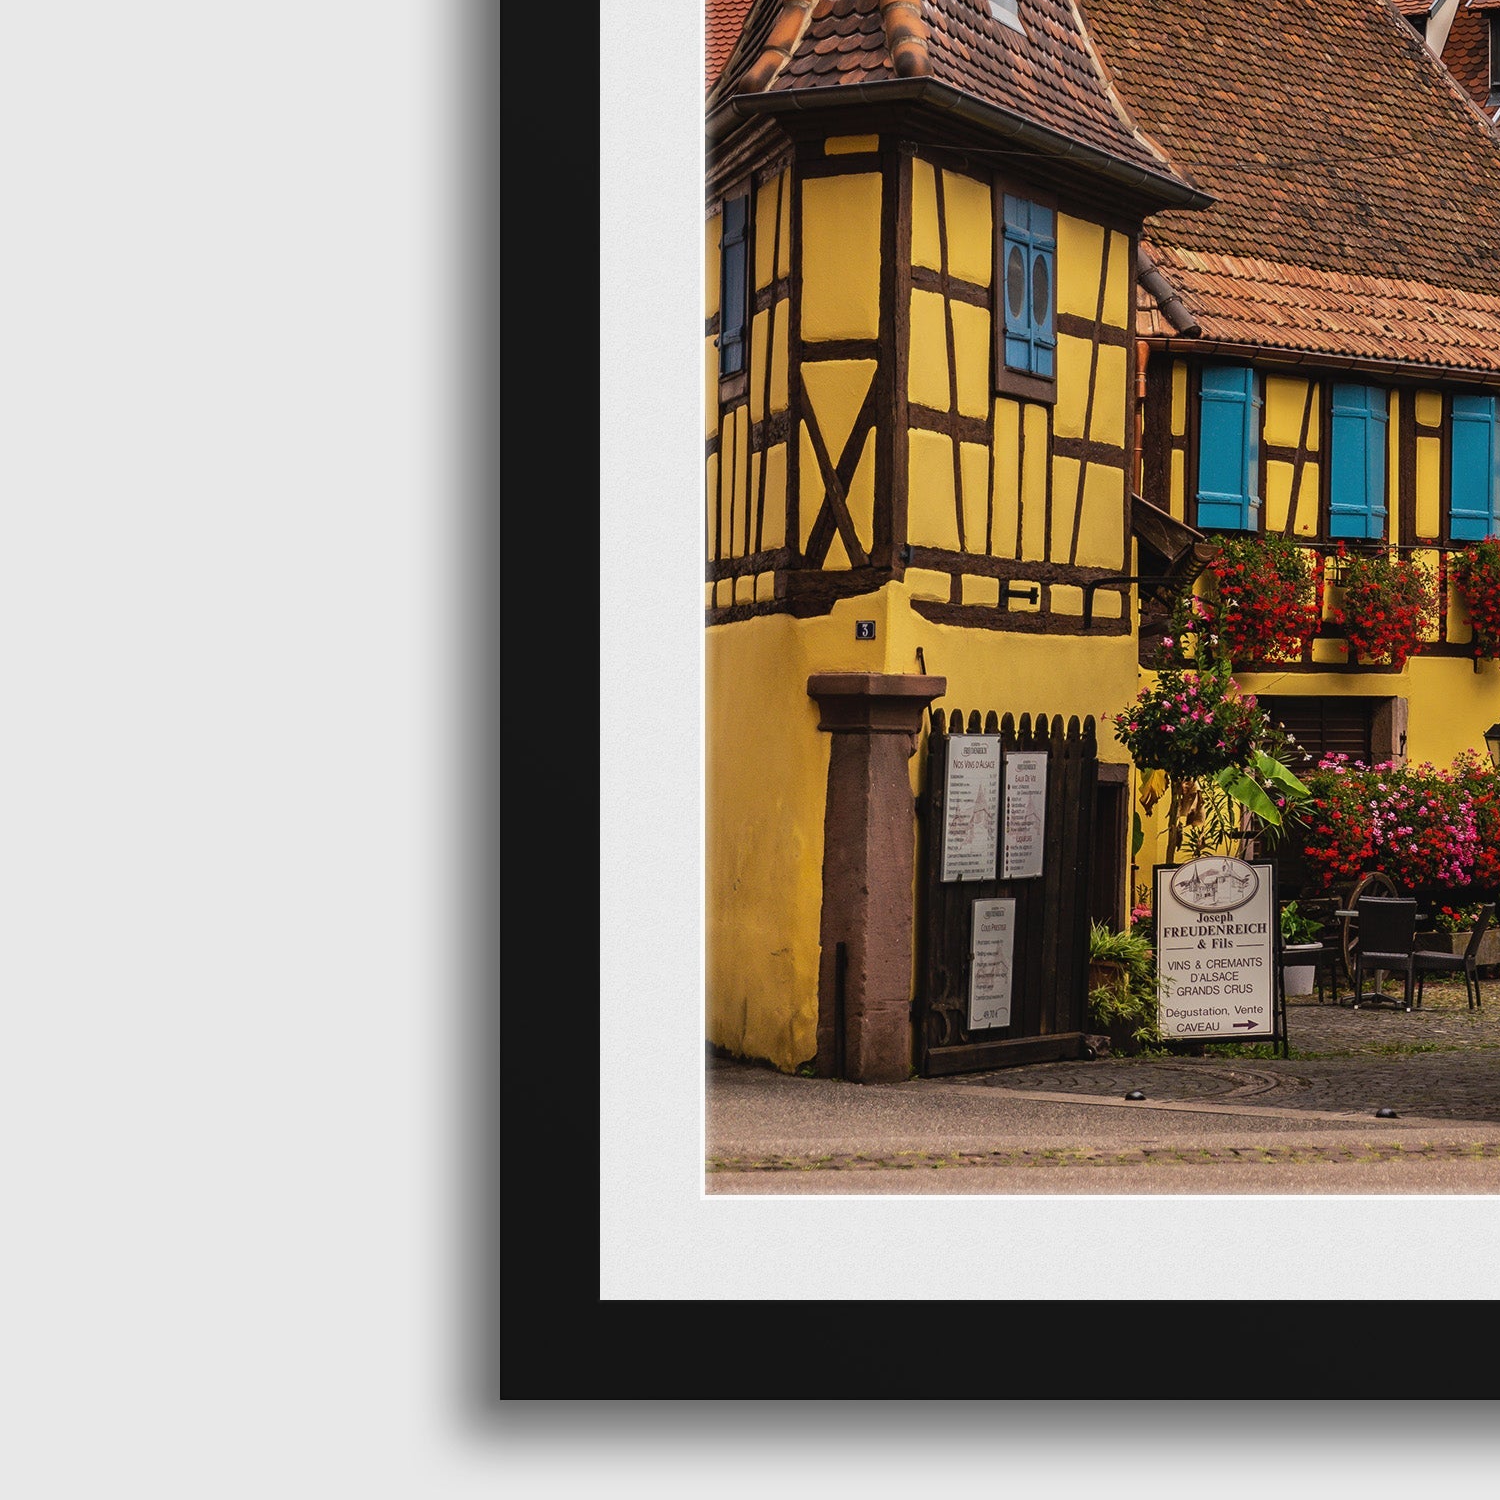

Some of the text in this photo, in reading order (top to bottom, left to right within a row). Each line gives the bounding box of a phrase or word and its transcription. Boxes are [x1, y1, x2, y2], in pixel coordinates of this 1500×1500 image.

[1196, 911, 1234, 924] Joseph
[1163, 922, 1267, 939] FREUDENREICH
[1197, 938, 1234, 950] & Fils
[1167, 957, 1263, 971] VINS & CREMANTS
[1190, 971, 1239, 983] D'ALSACE
[1176, 984, 1253, 997] GRANDS CRUS
[1165, 1005, 1264, 1019] Dégustation, Vente
[1176, 1022, 1220, 1033] CAVEAU
